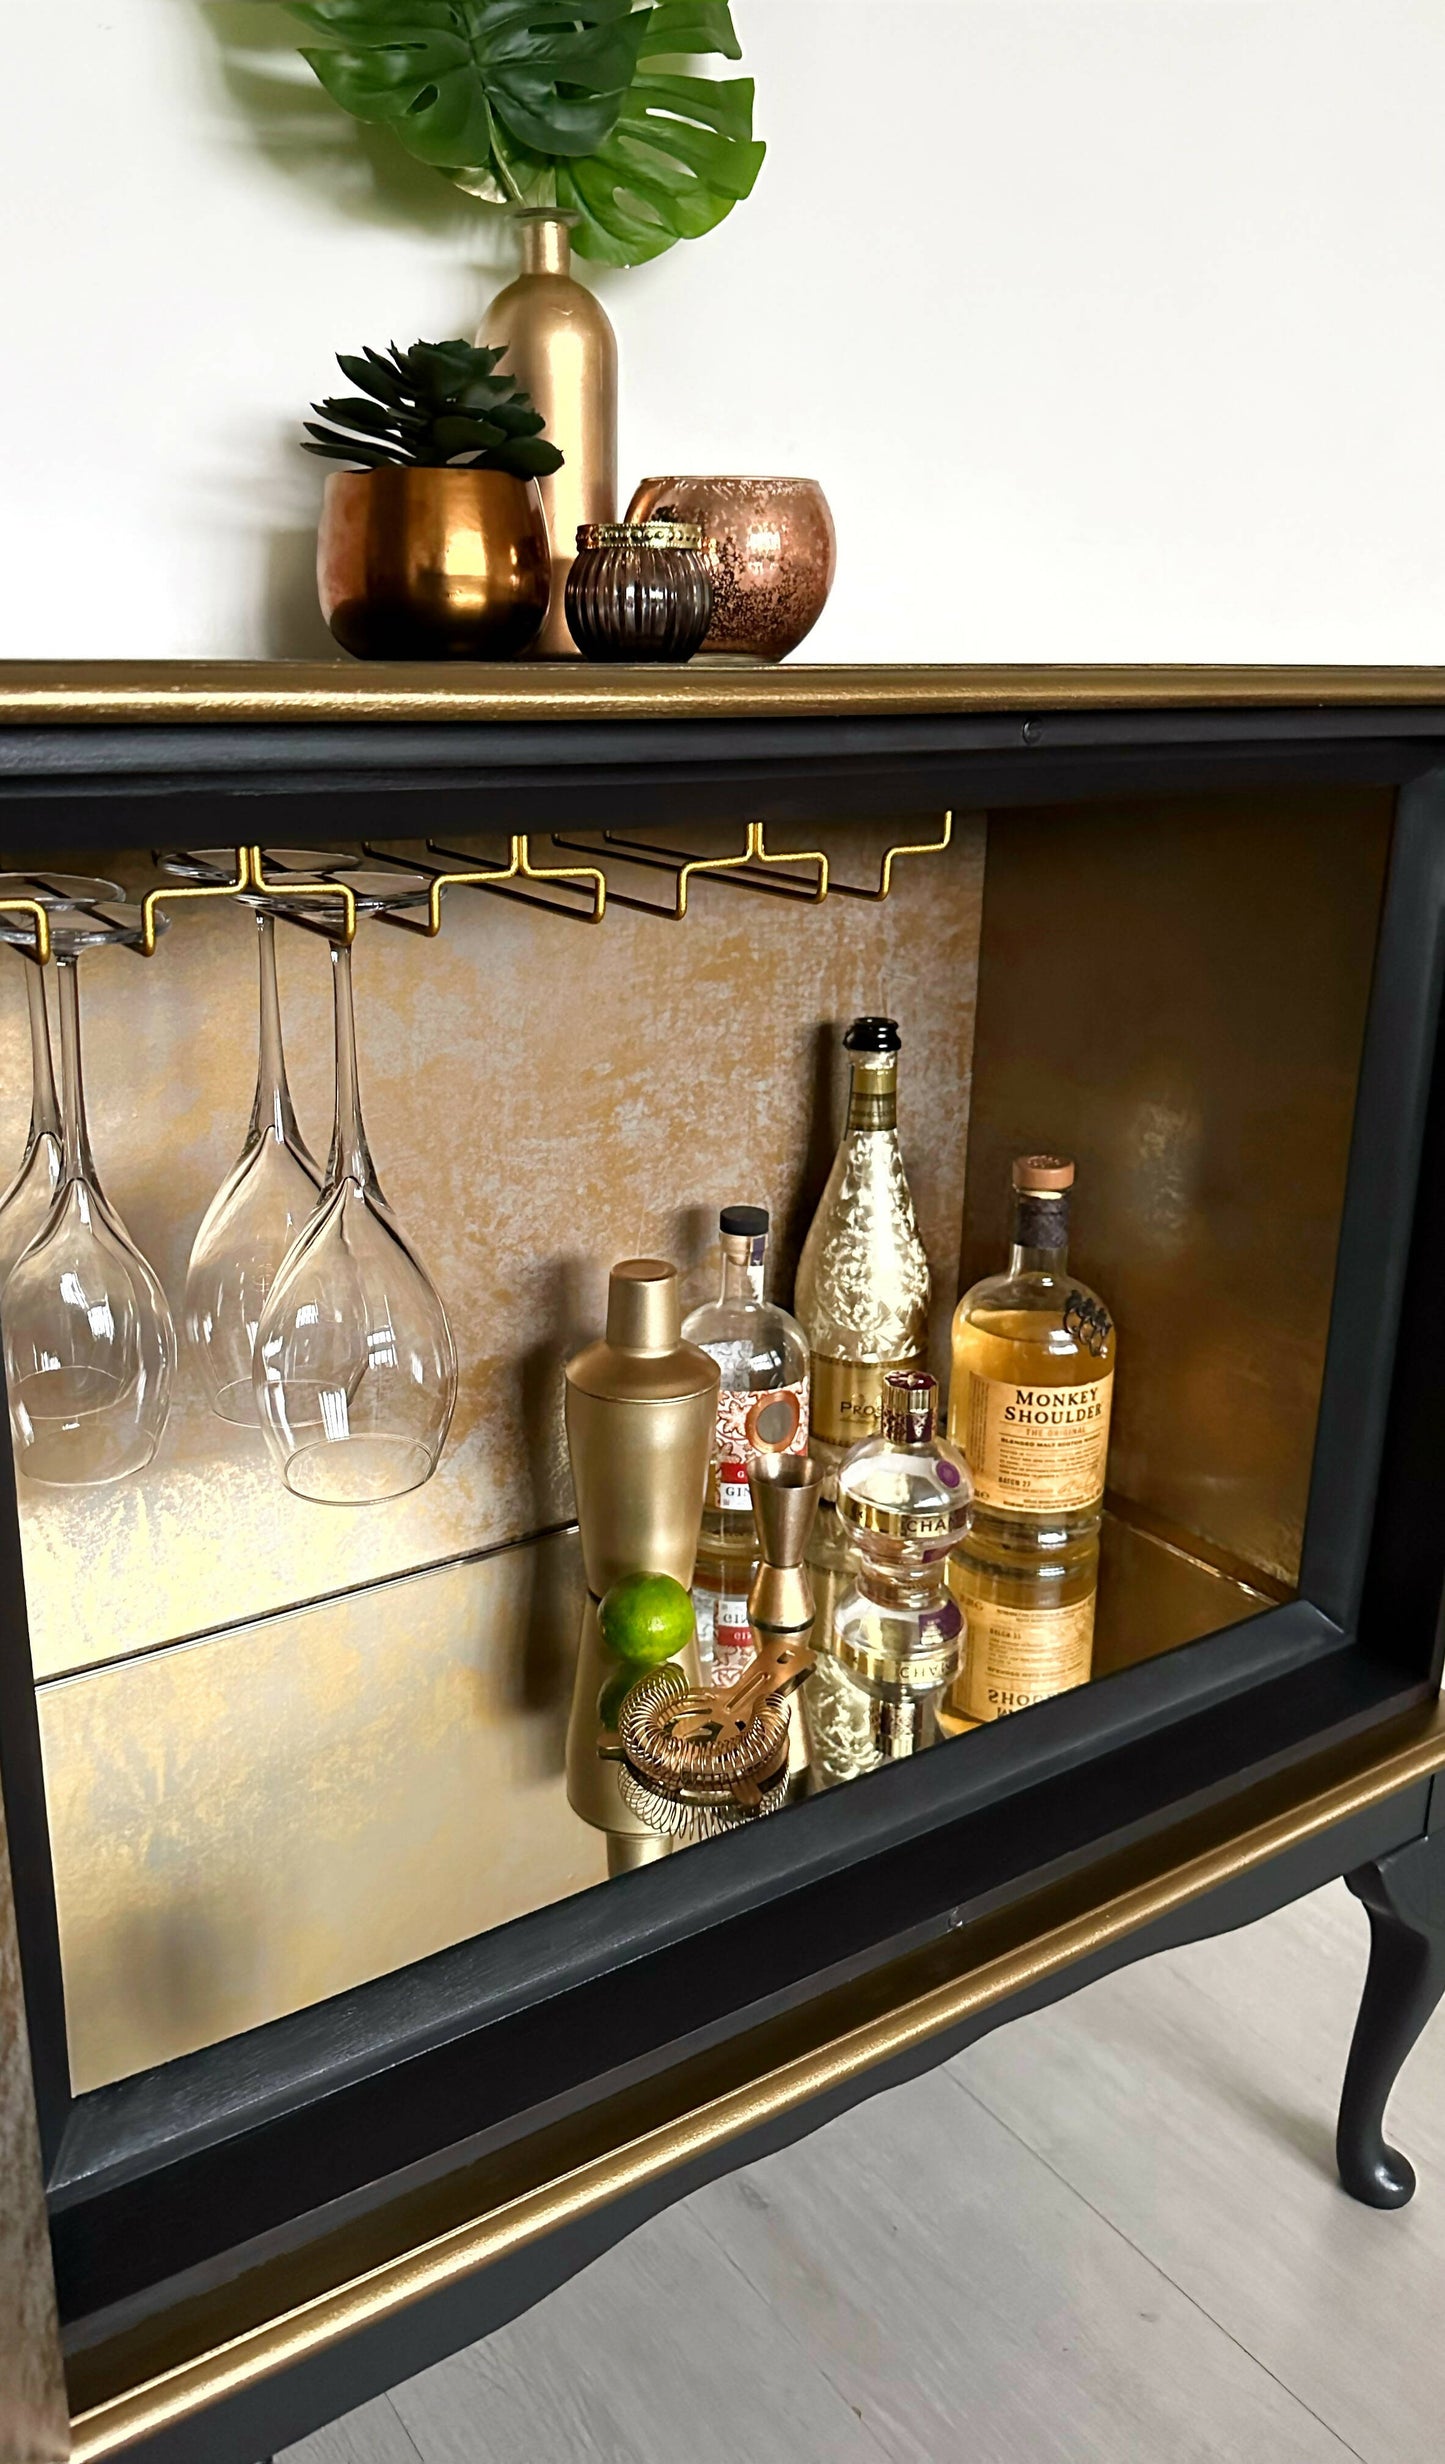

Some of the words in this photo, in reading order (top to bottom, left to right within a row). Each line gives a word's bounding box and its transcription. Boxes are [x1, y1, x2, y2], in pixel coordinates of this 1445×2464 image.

[1016, 1388, 1098, 1407] MONKEY
[1005, 1404, 1102, 1424] SHOULDER
[1026, 1428, 1043, 1436] THE
[1047, 1427, 1086, 1436] ORIGINAL
[1001, 1437, 1035, 1447] BLENDED
[999, 1477, 1020, 1487] BATCH
